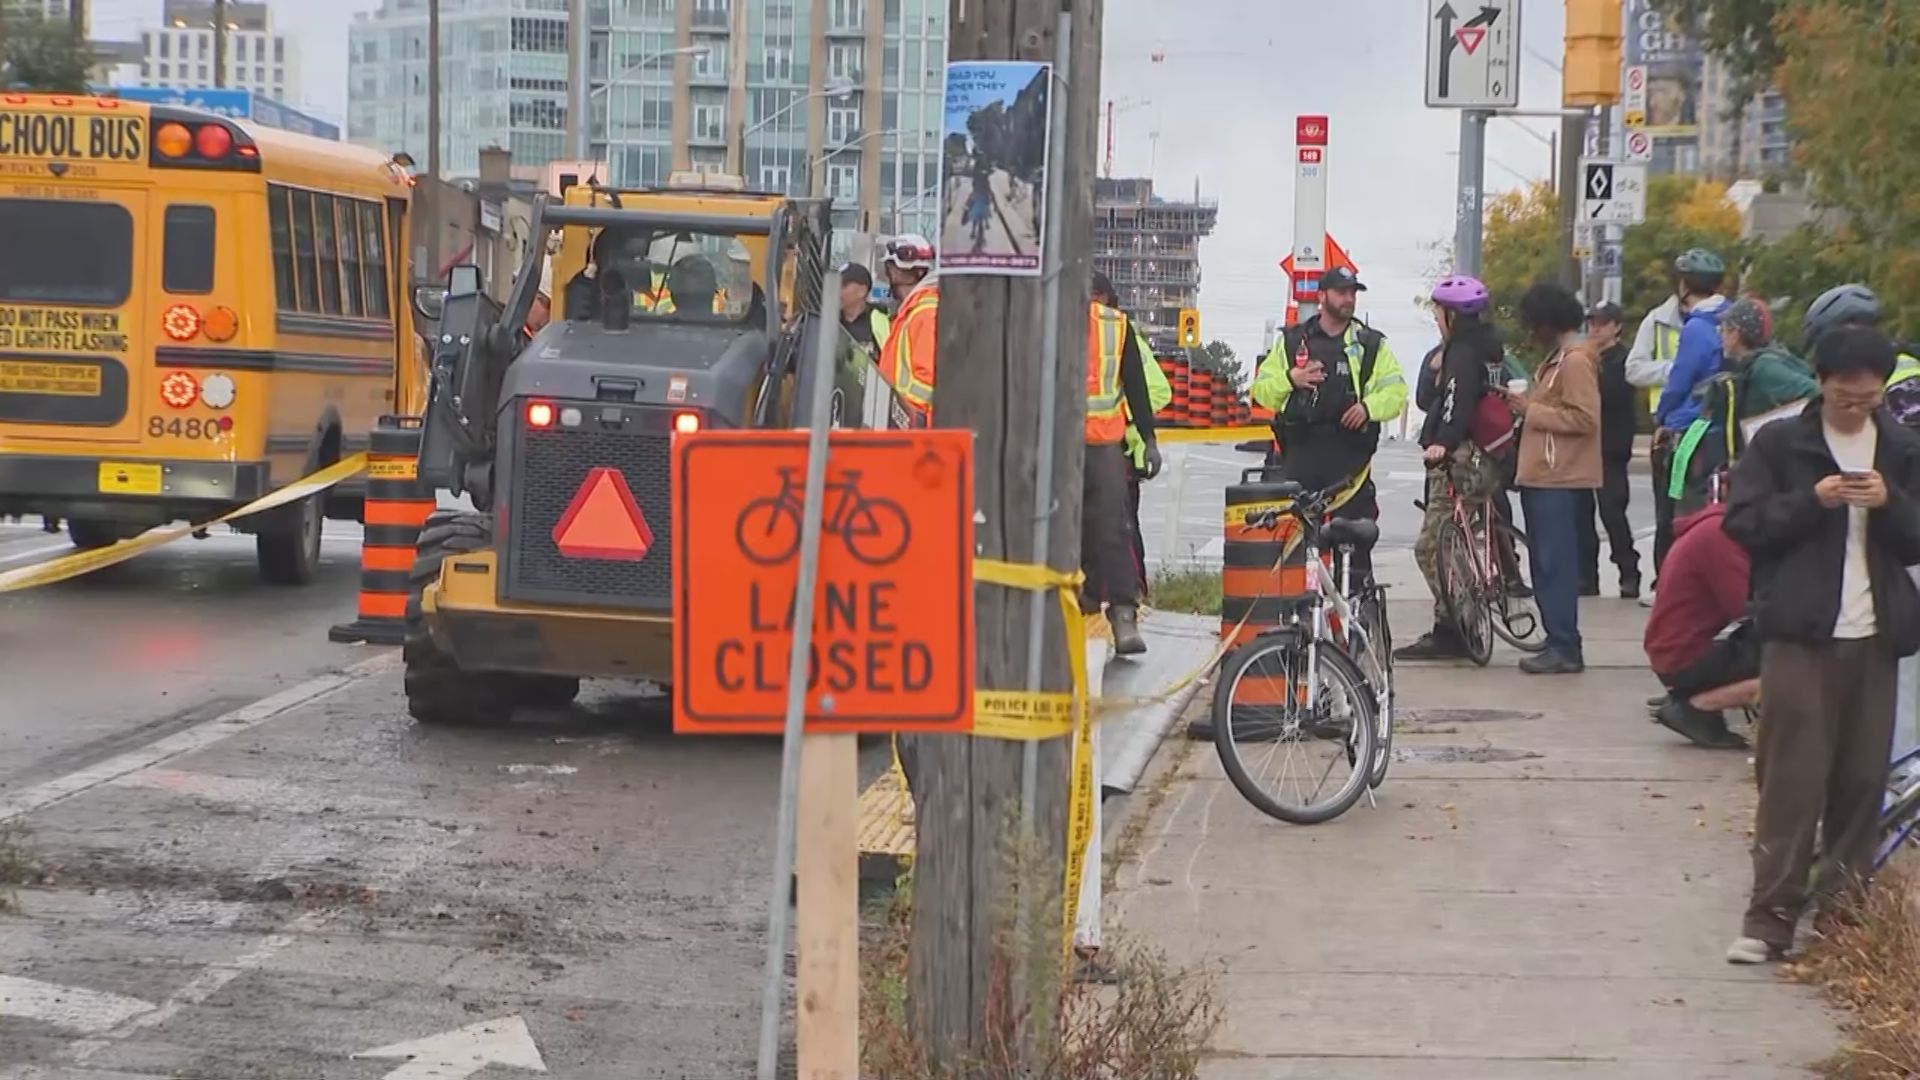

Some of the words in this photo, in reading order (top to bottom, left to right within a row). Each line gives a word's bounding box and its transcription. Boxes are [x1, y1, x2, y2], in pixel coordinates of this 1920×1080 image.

[974, 71, 996, 80] YOU
[90, 117, 140, 159] BUS
[20, 309, 42, 327] NOT
[46, 311, 80, 329] PASS
[81, 313, 119, 331] WHEN
[16, 330, 61, 348] LIGHTS
[64, 332, 128, 352] FLASHING
[148, 415, 220, 440] 8480
[714, 639, 933, 693] CLOSED
[984, 699, 1028, 711] POLICE
